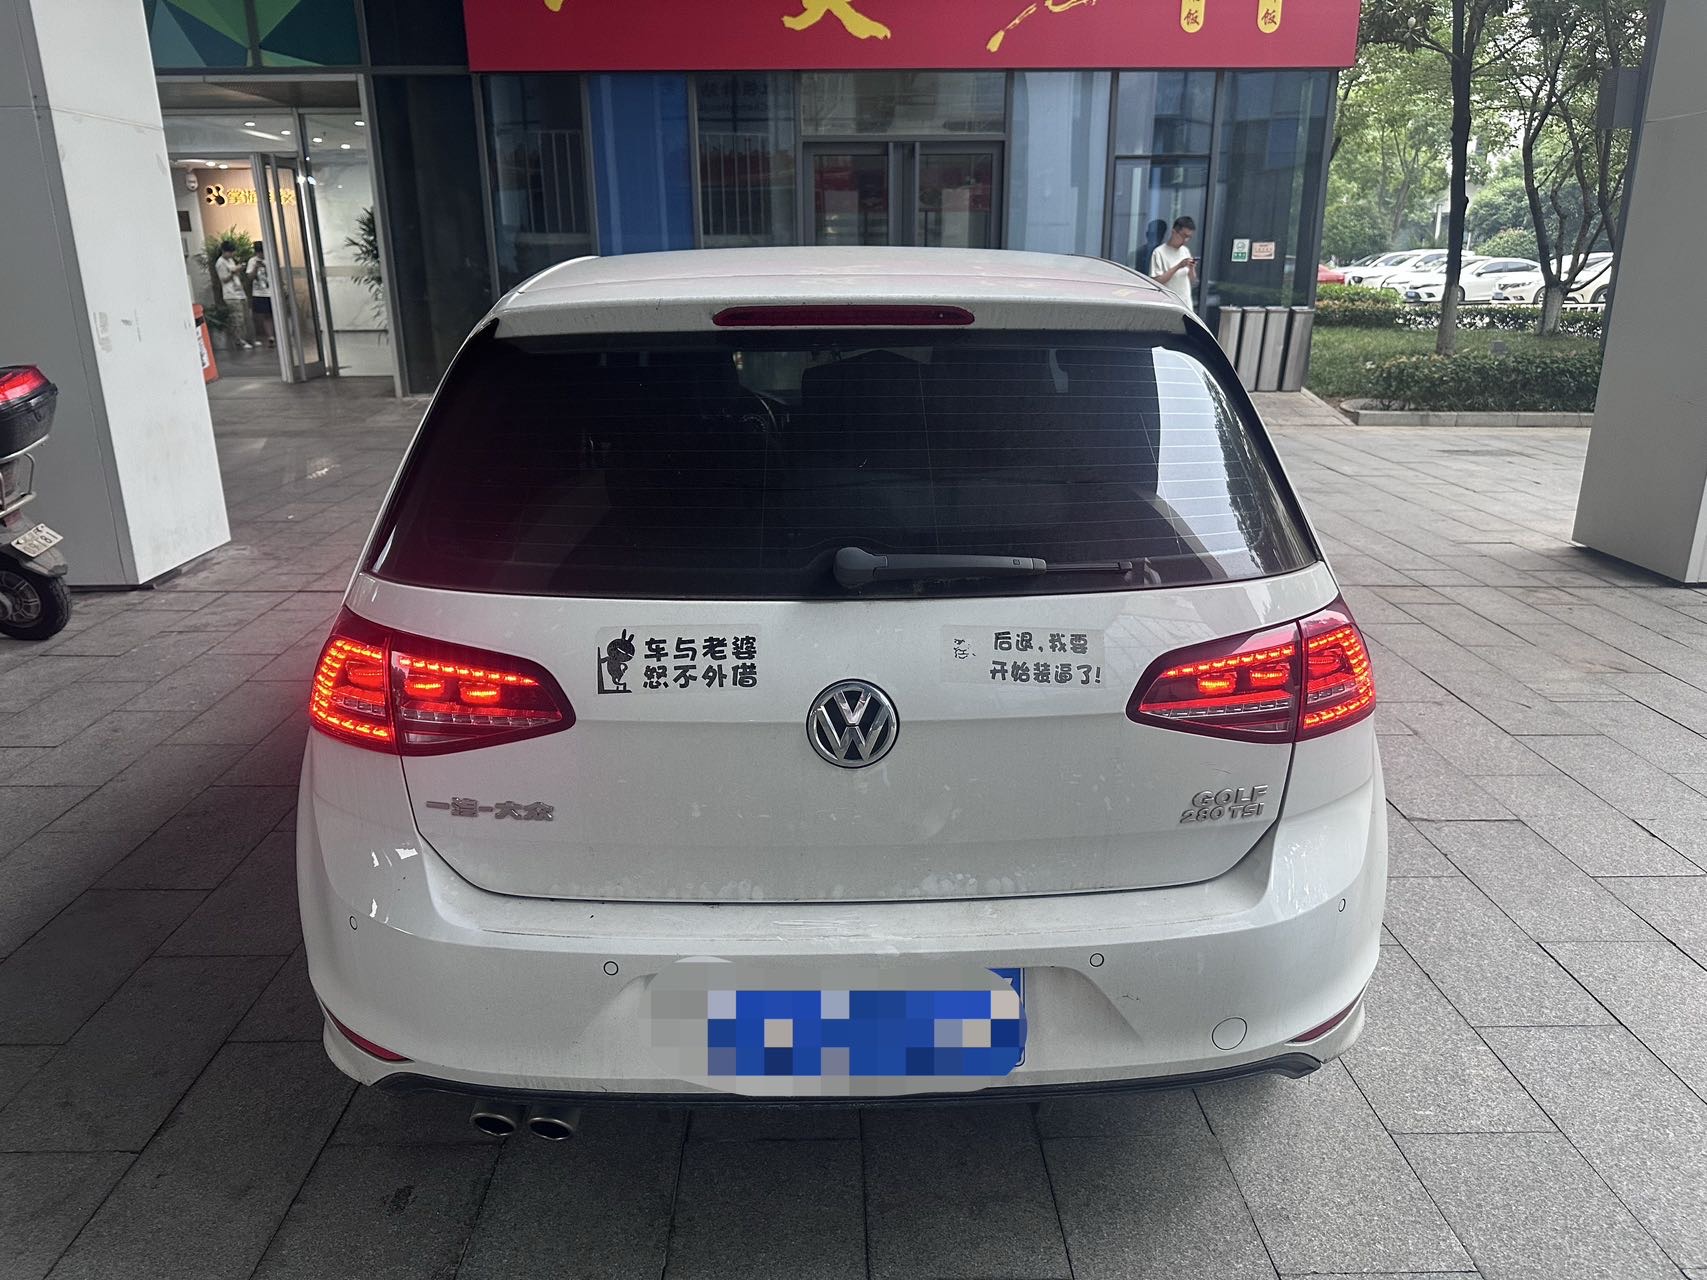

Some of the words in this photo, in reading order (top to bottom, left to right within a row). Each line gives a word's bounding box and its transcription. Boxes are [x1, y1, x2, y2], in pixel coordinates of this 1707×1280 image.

[644, 635, 757, 662] 车与老婆
[1192, 785, 1269, 808] GOLF
[1179, 805, 1225, 824] 280
[1228, 802, 1265, 819] TSI
